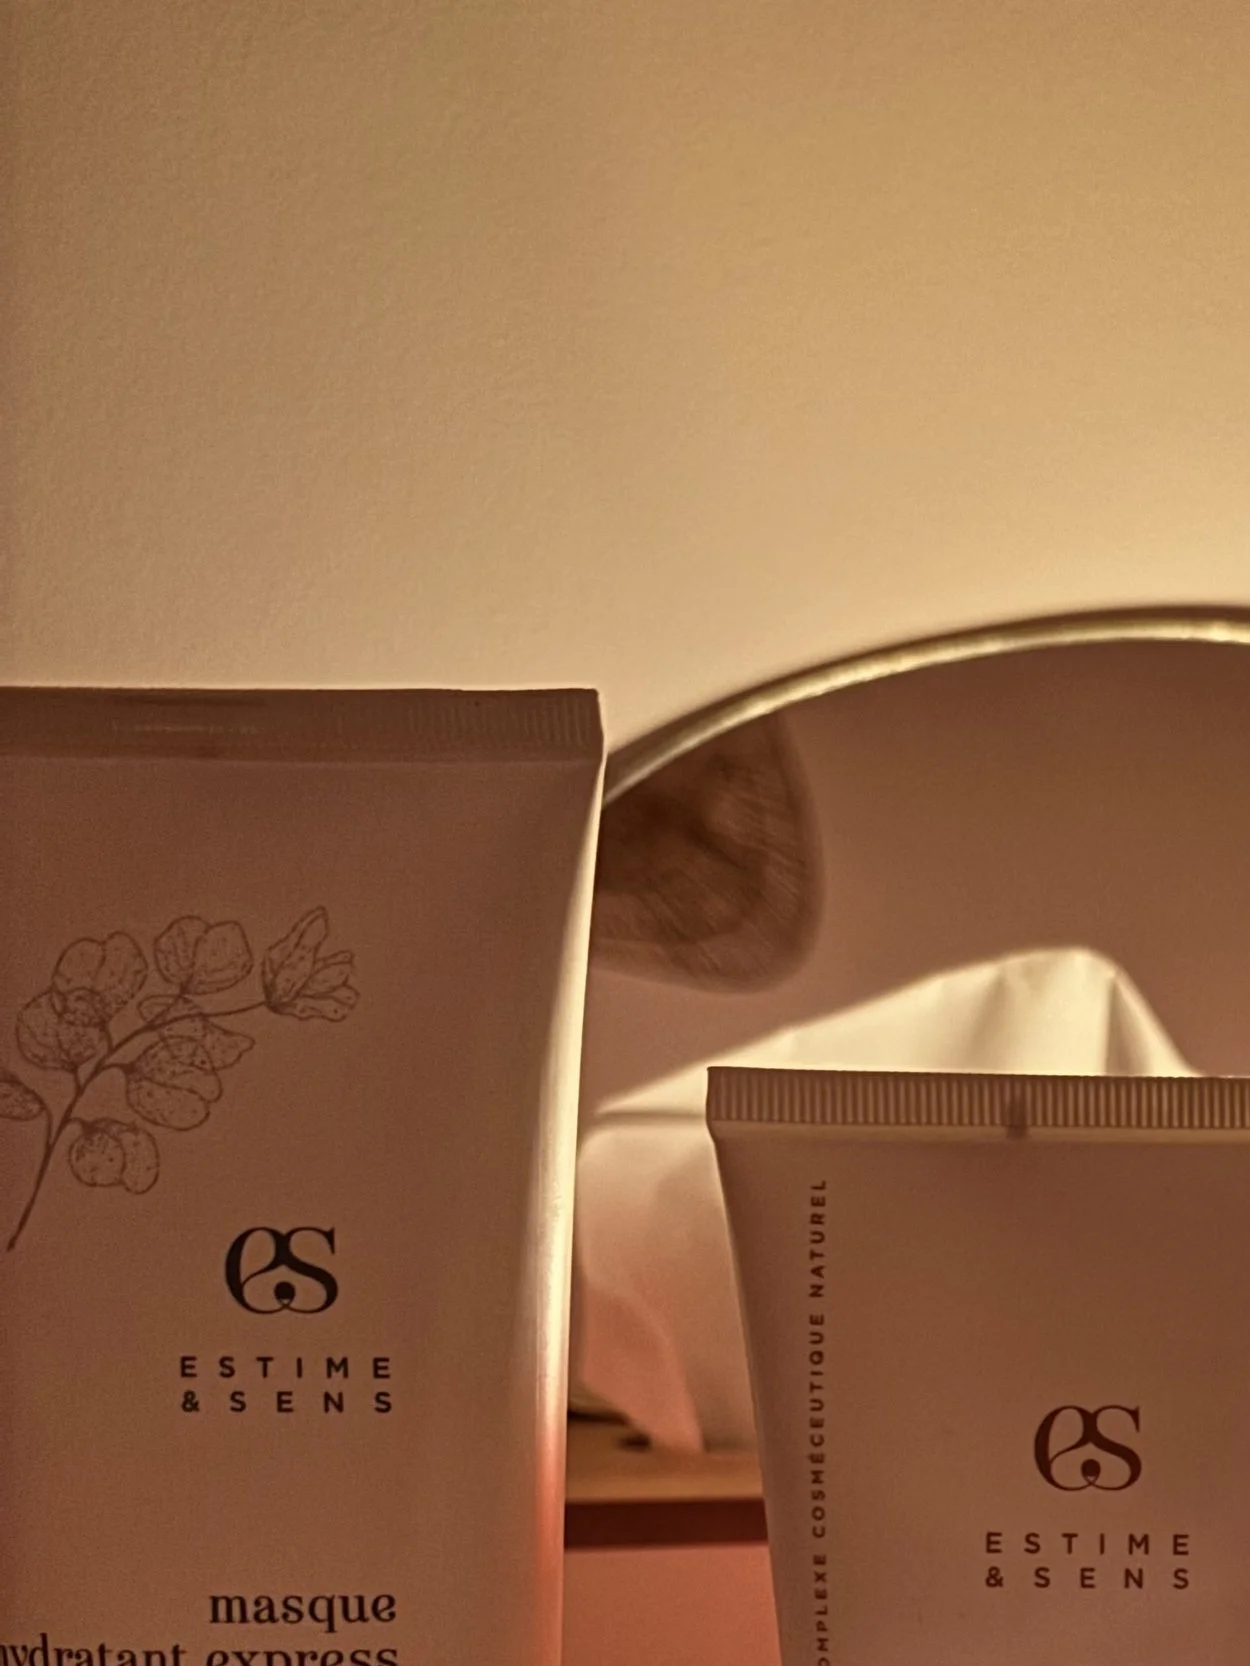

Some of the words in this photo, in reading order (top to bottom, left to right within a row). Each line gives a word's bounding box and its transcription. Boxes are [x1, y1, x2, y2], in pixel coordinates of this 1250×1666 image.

[808, 1180, 827, 1298] NATUREL
[179, 1355, 391, 1380] ESTIME
[180, 1389, 200, 1413] &
[229, 1390, 393, 1414] SENS
[807, 1314, 826, 1539] COSMÉCEUTIQUE
[985, 1531, 1190, 1556] ESTIME
[985, 1565, 1004, 1588] &
[1033, 1566, 1189, 1590] SENS
[209, 1594, 397, 1634] masque
